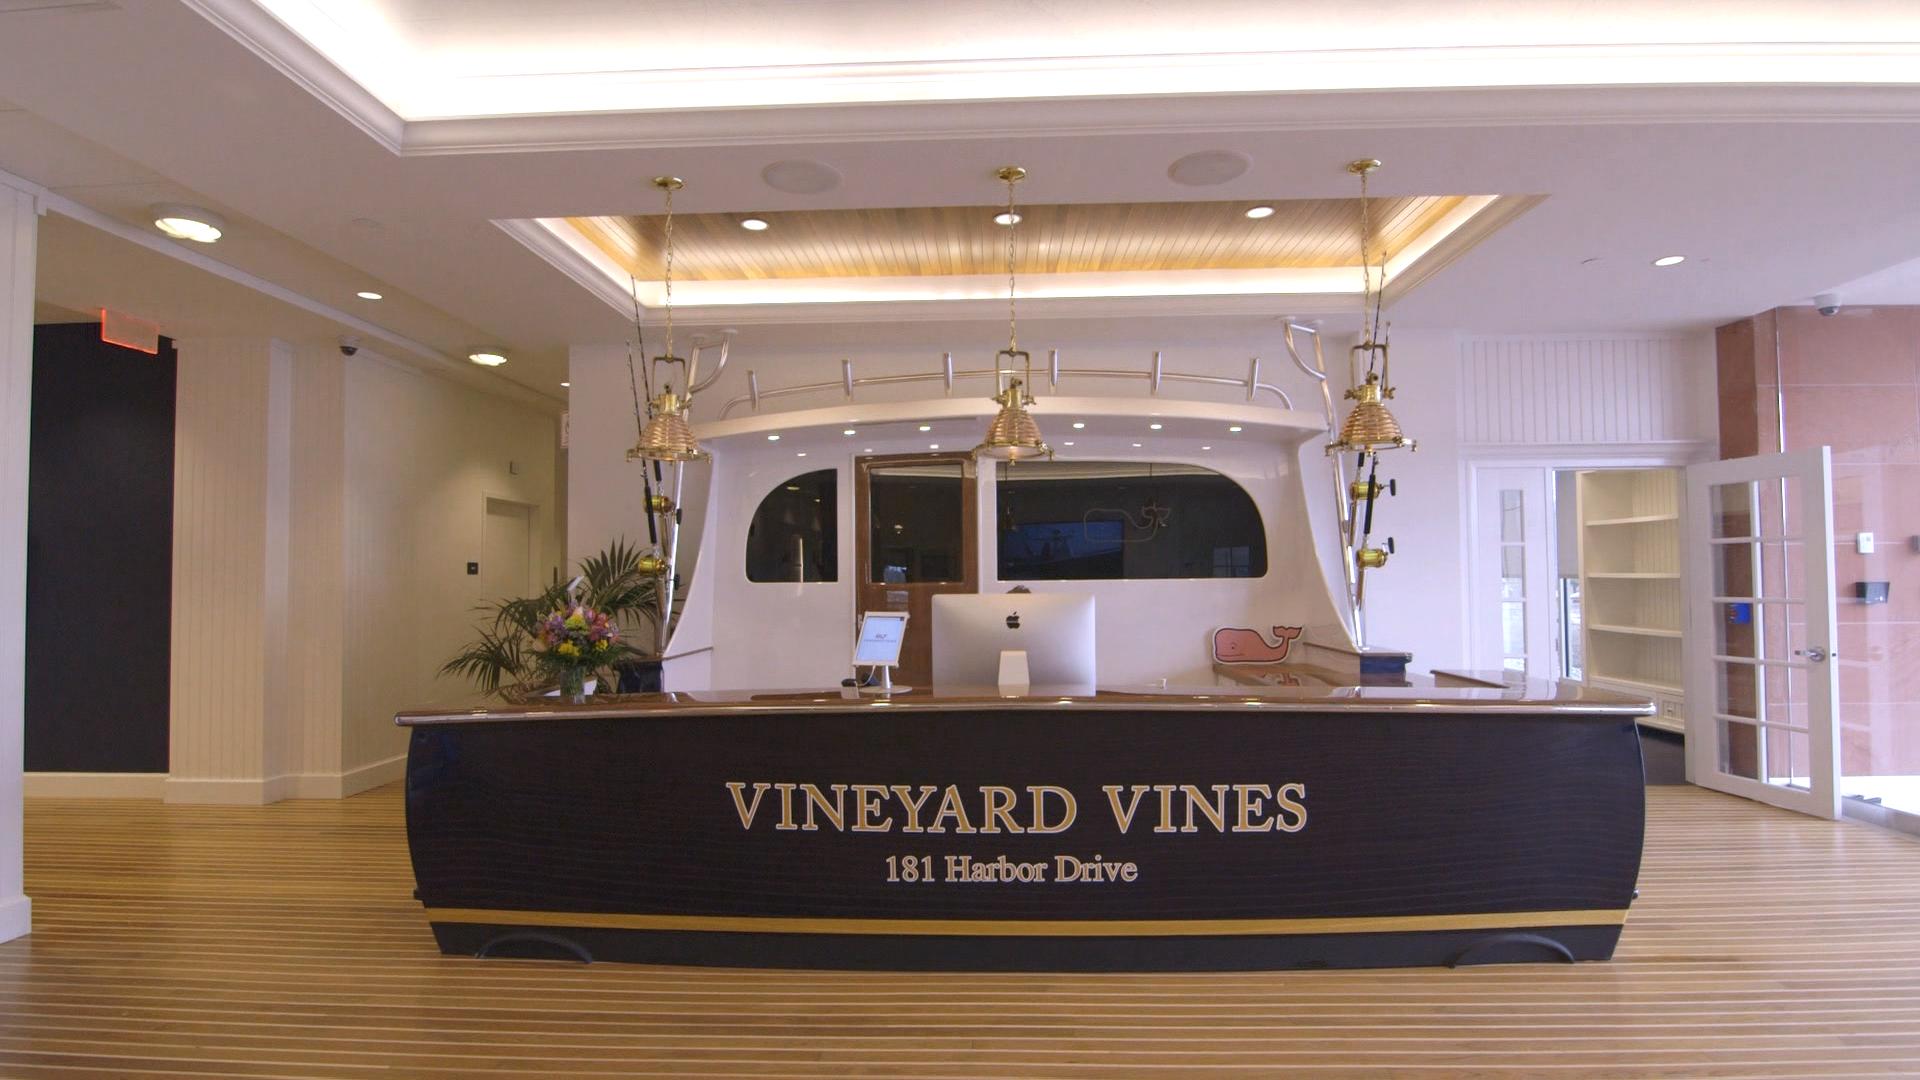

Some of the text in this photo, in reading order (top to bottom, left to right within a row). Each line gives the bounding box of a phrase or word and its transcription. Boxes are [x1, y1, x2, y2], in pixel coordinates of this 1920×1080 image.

[725, 781, 1308, 834] VINEYARD VINES
[886, 854, 1139, 883] 181 Harbor Drive
